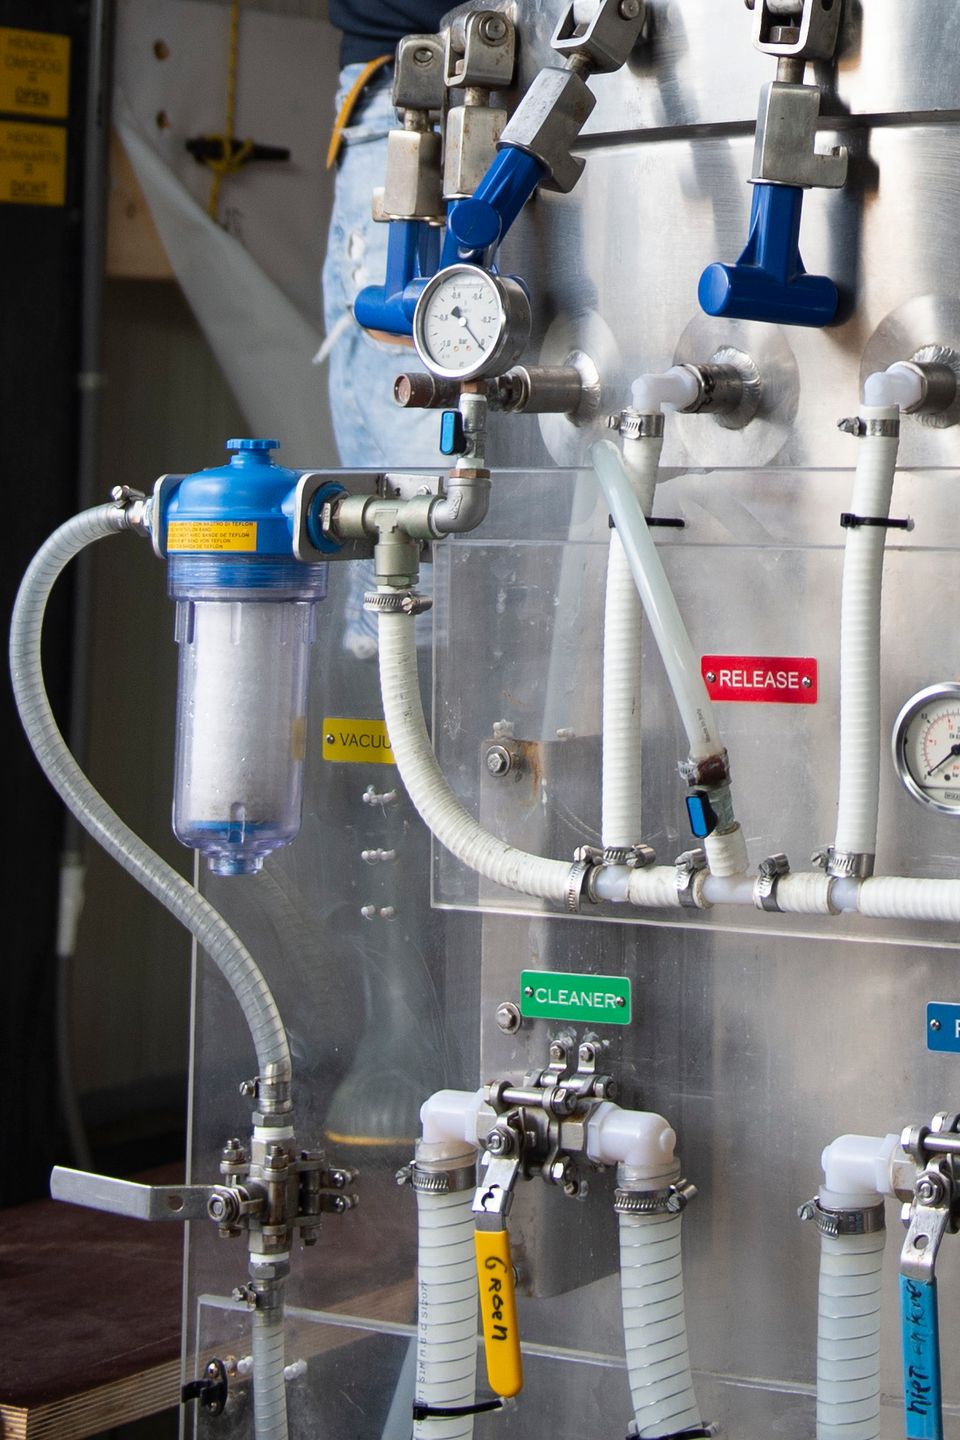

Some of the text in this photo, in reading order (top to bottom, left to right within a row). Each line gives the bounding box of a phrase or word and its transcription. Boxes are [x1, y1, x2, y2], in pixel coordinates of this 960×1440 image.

[719, 669, 799, 689] RELEASE
[339, 732, 393, 749] VACUU
[535, 987, 616, 1009] CLEANER
